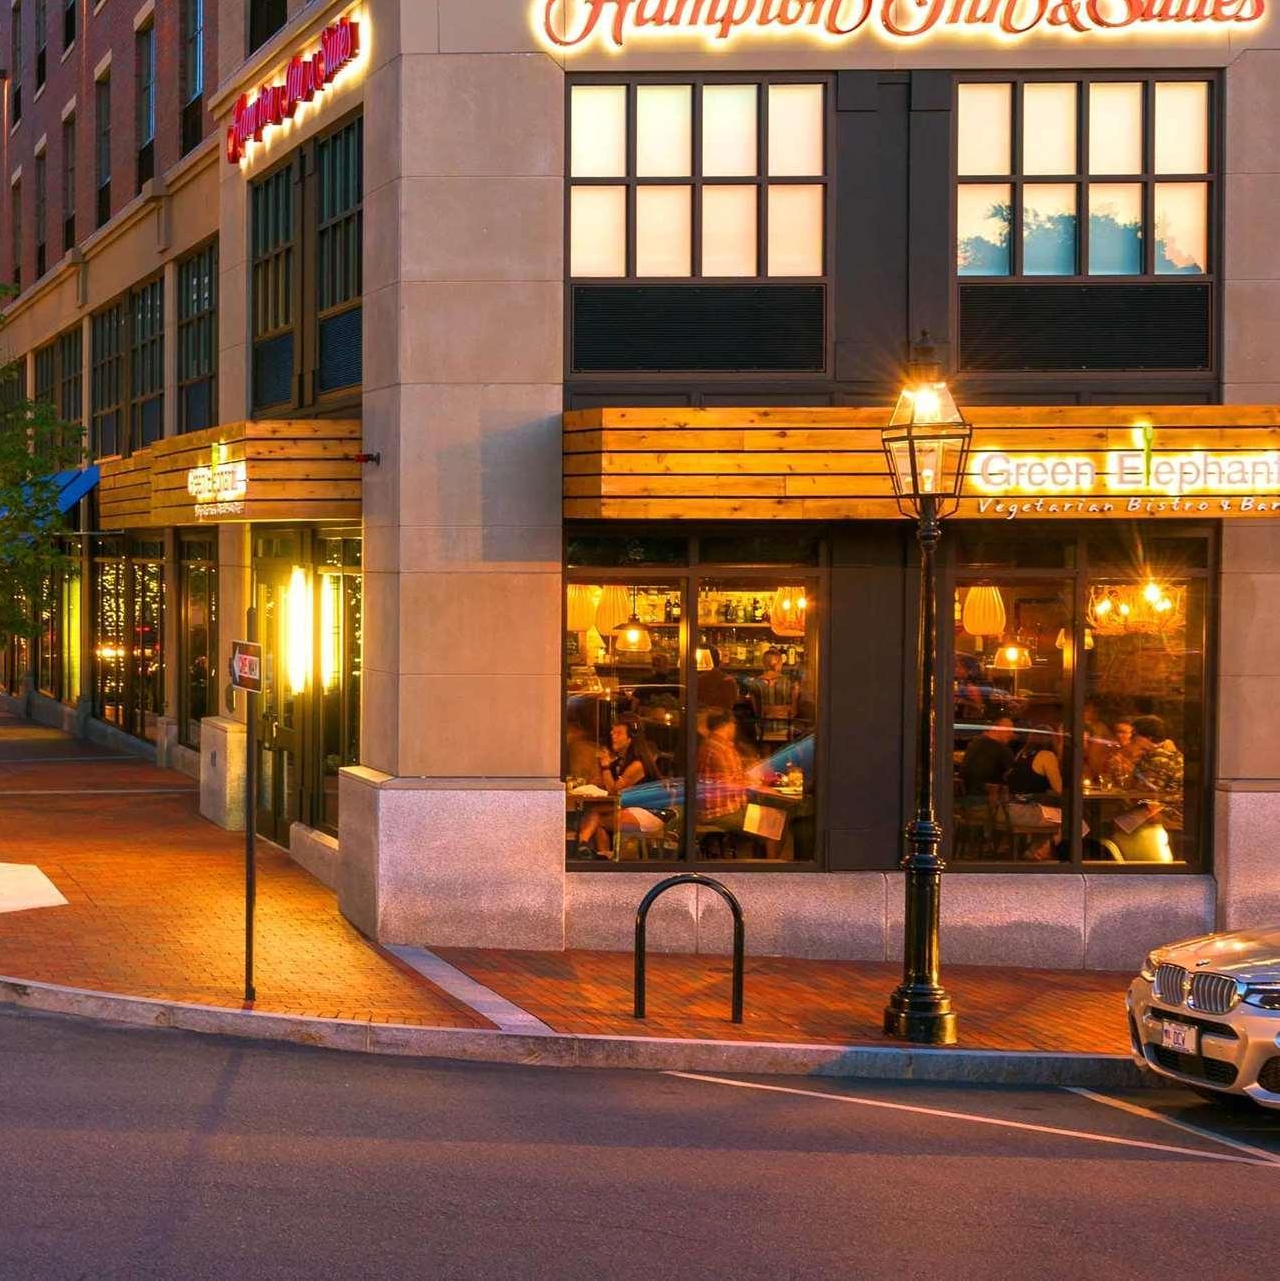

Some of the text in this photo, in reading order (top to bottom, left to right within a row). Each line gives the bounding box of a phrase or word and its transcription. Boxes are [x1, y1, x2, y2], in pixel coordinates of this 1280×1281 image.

[979, 453, 1096, 488] Green
[978, 497, 1114, 519] Vegetarian
[1127, 497, 1210, 513] Bistro
[1240, 497, 1280, 513] Bar
